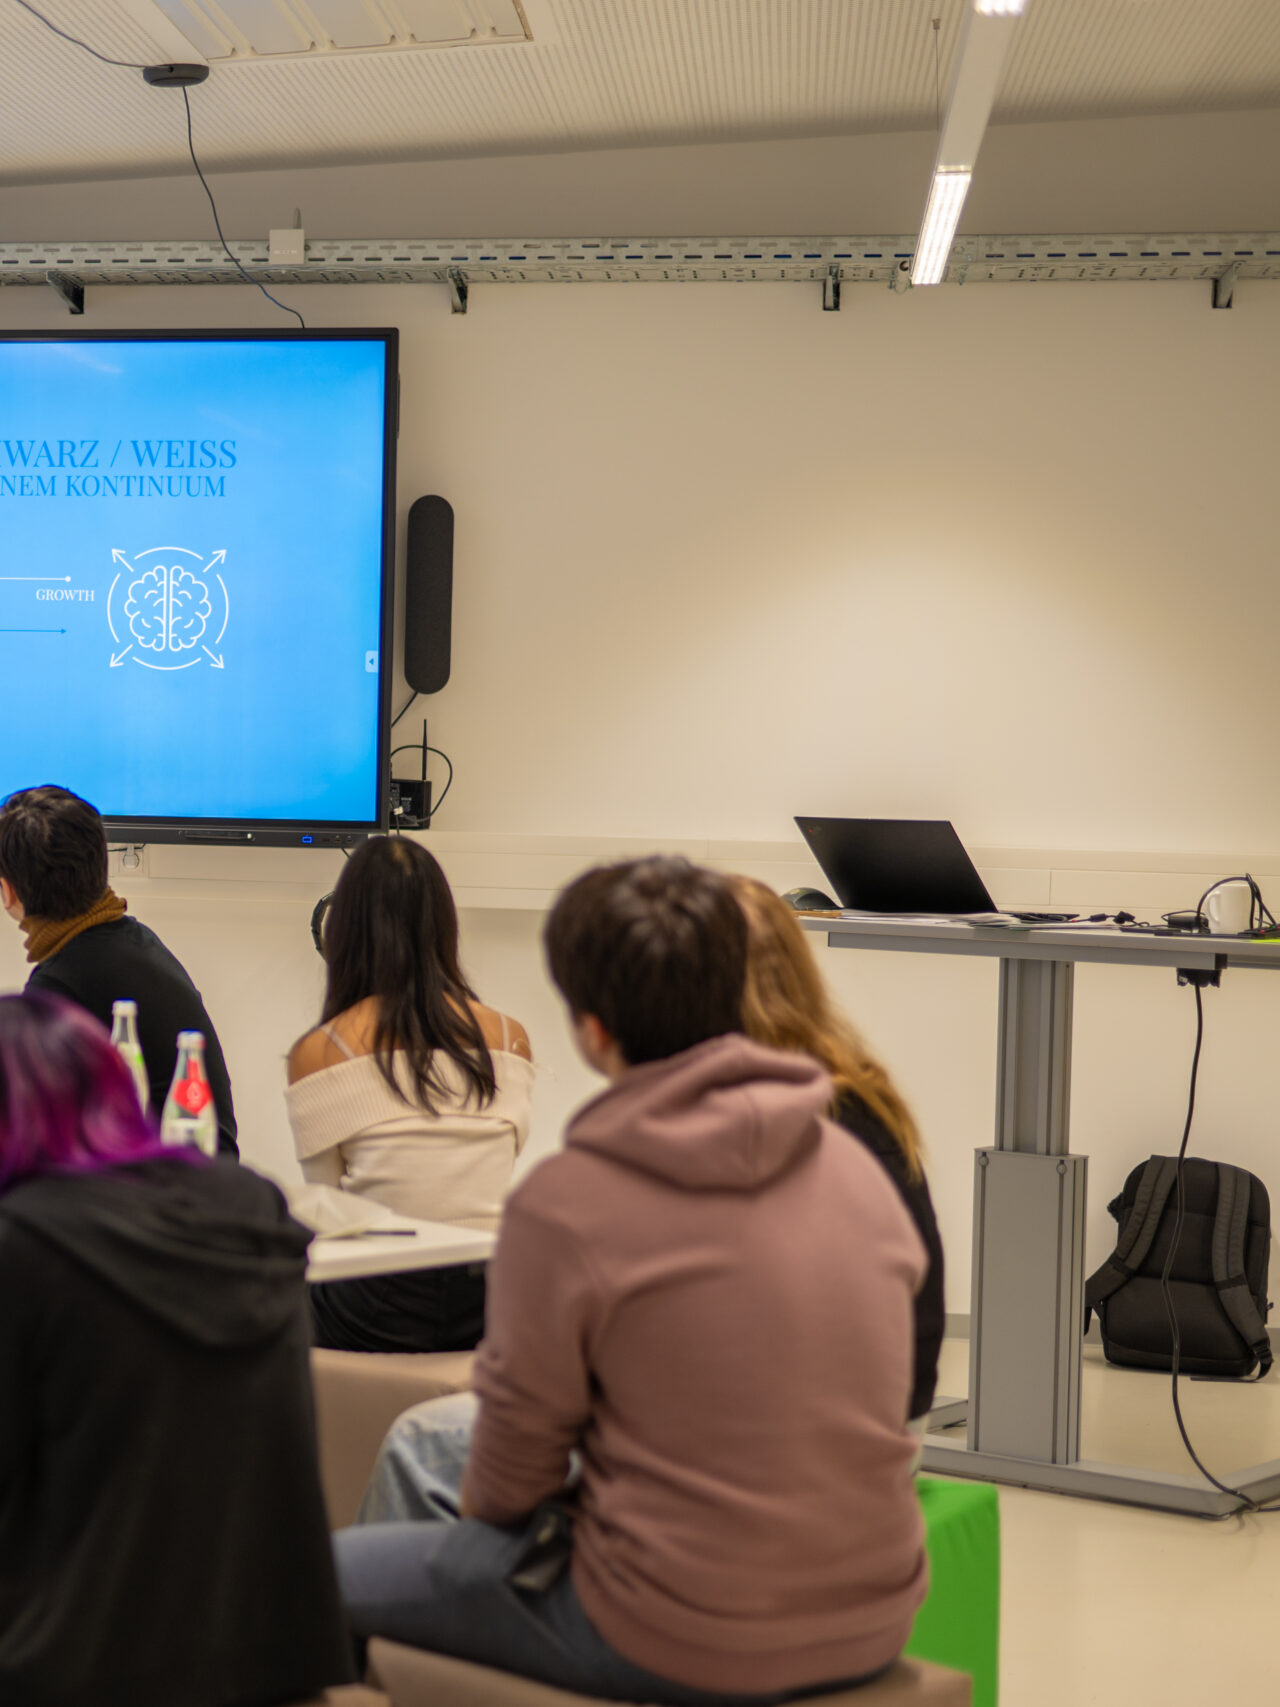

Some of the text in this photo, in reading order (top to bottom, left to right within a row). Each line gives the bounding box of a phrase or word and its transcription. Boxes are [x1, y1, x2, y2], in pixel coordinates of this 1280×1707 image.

[110, 439, 122, 468] /
[130, 439, 237, 469] WEISS
[65, 475, 226, 498] KONTINUUM
[35, 589, 96, 602] GROWTH
